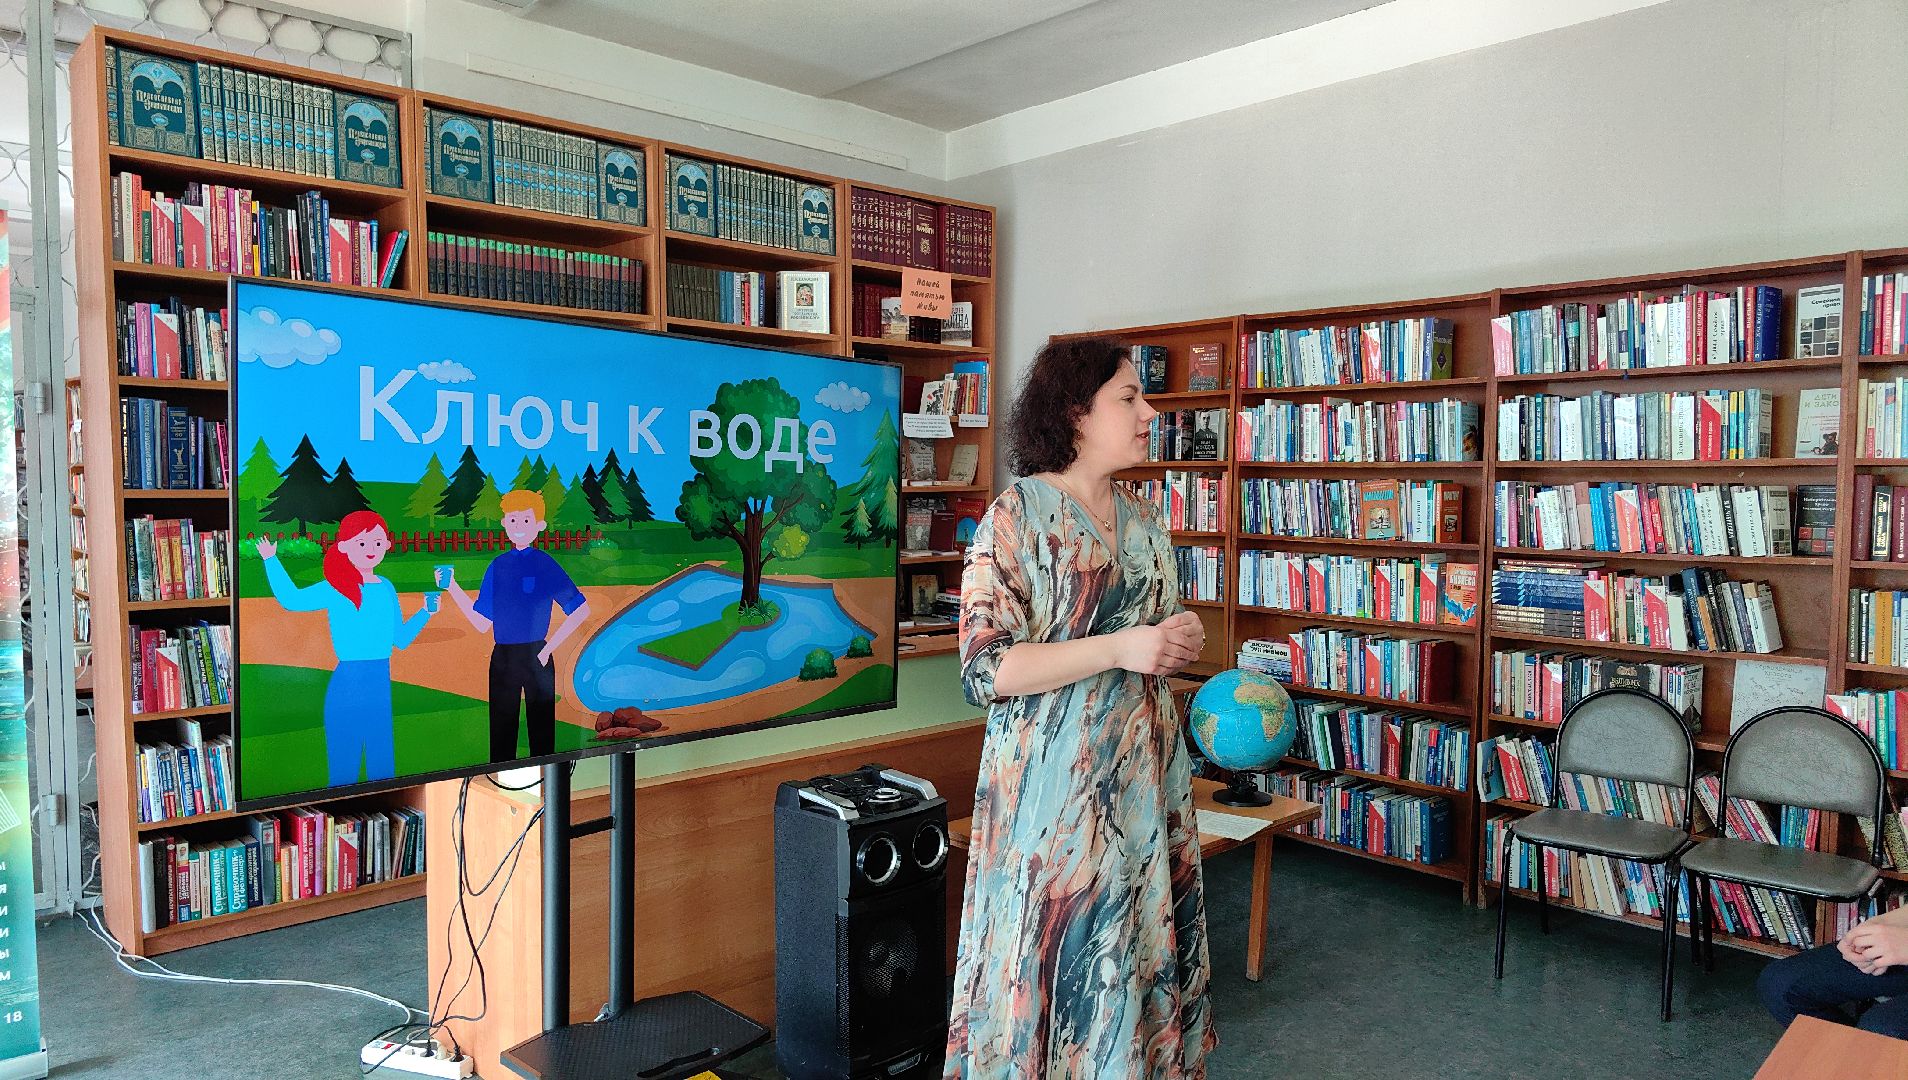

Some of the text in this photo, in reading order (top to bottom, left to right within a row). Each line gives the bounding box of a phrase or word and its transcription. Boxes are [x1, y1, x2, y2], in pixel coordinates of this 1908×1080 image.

[359, 365, 837, 473] Ключ к воде
[1814, 400, 1839, 408] ЗАКО
[213, 858, 225, 912] Справочник
[232, 857, 243, 910] Справочник
[4, 1011, 23, 1024] 18
